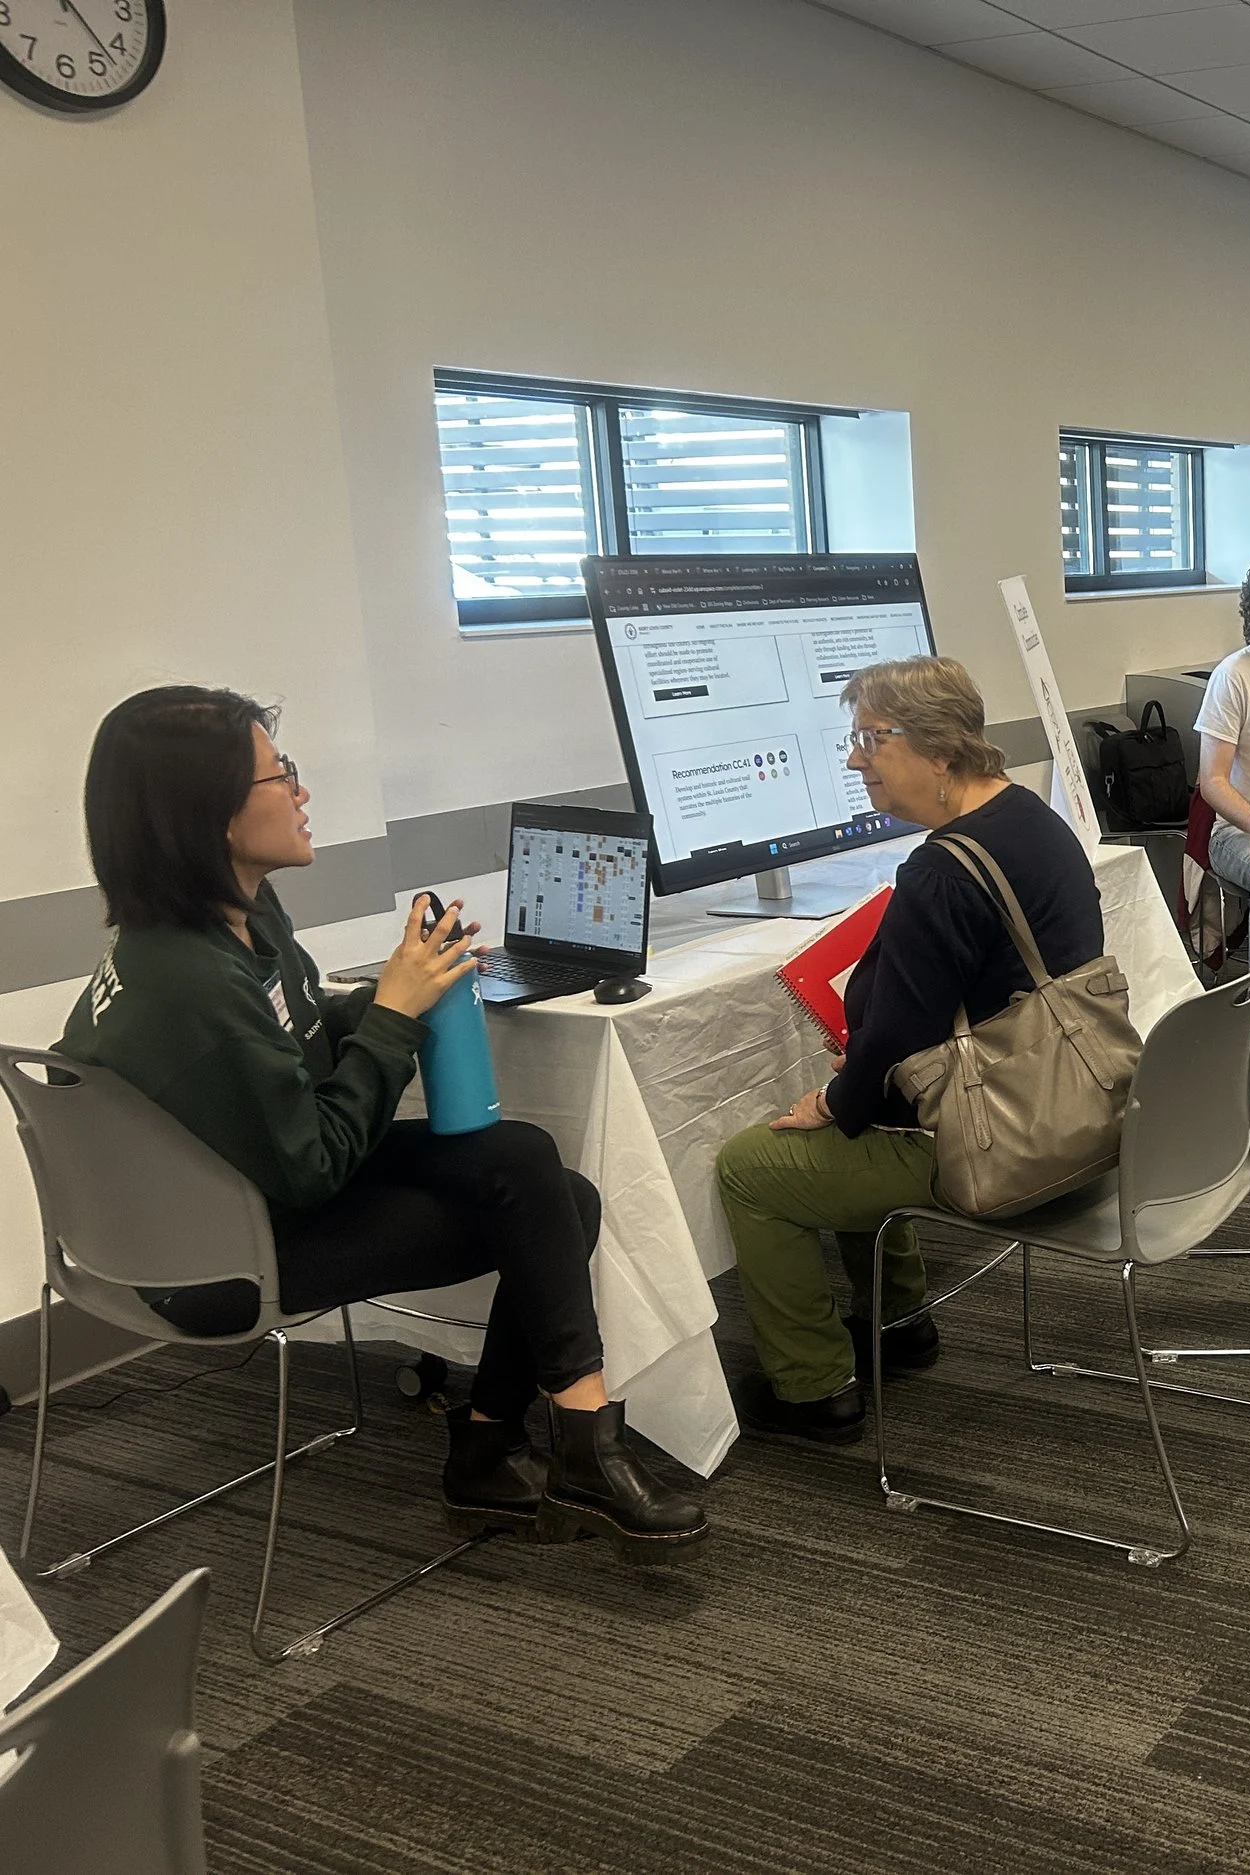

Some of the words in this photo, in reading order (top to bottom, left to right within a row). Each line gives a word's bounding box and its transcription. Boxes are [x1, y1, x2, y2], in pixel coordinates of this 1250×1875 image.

[115, 0, 132, 22] 3
[19, 33, 37, 60] 7
[110, 33, 126, 55] 4
[56, 53, 76, 79] 6
[88, 51, 107, 76] 5
[672, 762, 732, 779] Recommendation
[733, 759, 751, 769] CC.41
[305, 1019, 323, 1040] SAINT
